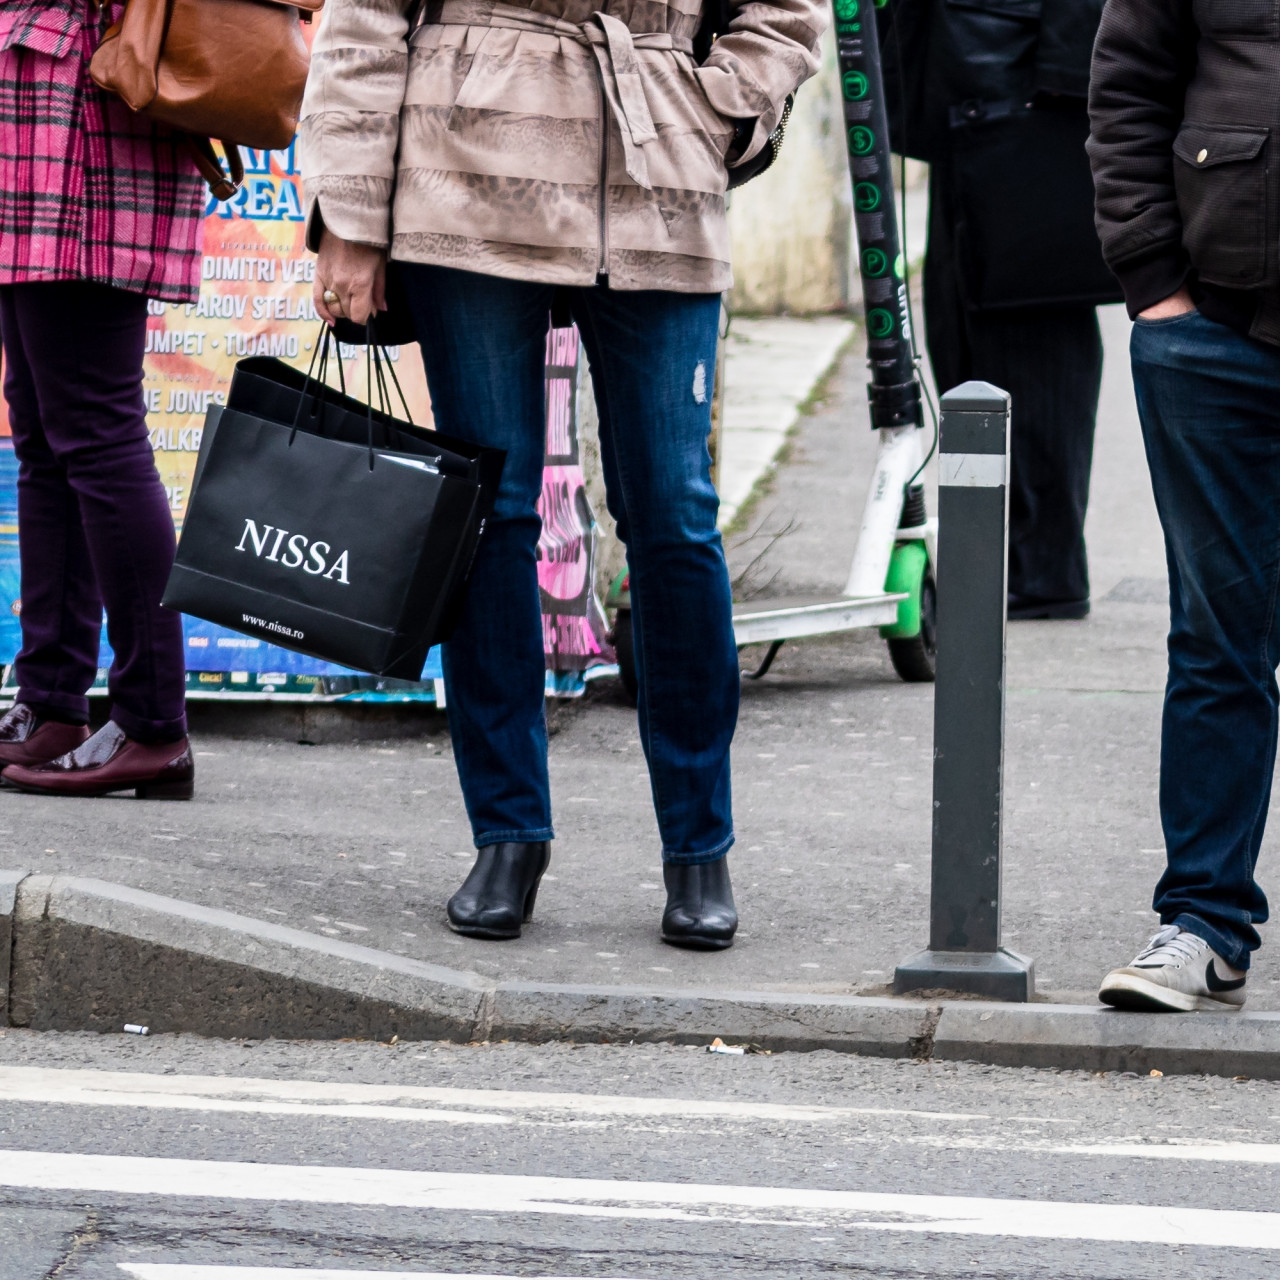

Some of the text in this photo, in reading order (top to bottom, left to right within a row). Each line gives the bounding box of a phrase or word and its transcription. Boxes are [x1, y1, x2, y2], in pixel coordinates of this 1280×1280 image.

[202, 256, 275, 282] DIMITRI
[185, 295, 247, 320] PAROV
[224, 332, 299, 359] TUJAMO
[235, 518, 350, 585] NISSA
[242, 613, 305, 640] www.nissa.ro
